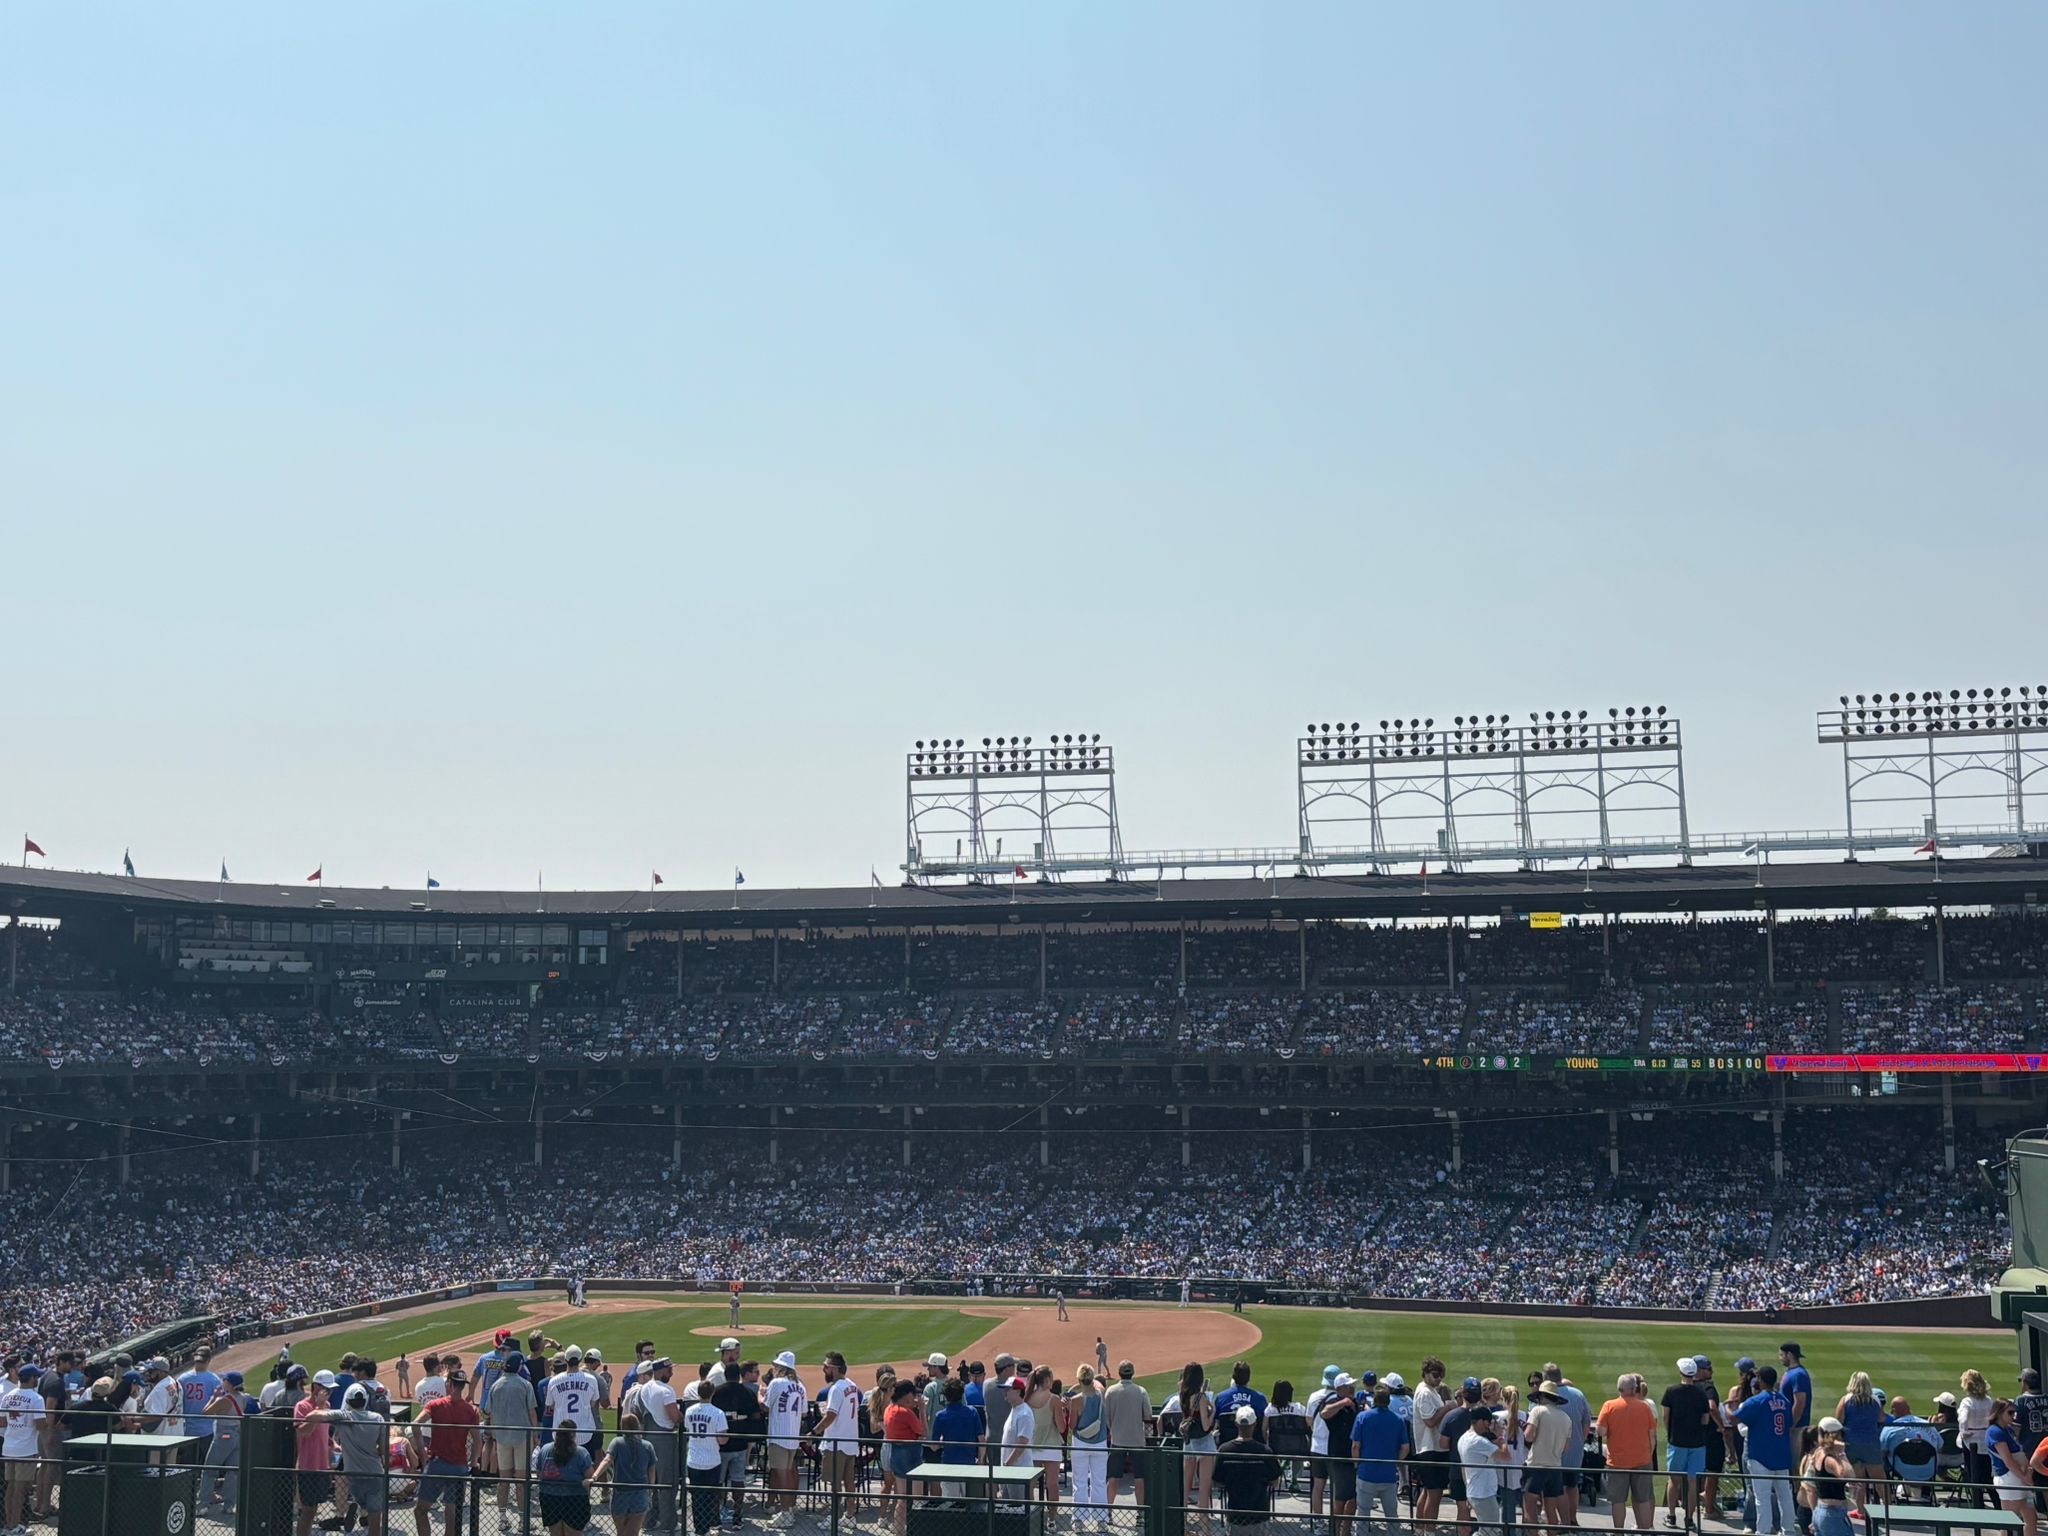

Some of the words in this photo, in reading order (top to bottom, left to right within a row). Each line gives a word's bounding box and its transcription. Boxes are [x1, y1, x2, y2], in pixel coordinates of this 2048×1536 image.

[1436, 1057, 1454, 1068] 4TH
[1480, 1057, 1486, 1068] 2
[1514, 1057, 1520, 1068] 2
[1565, 1057, 1599, 1069] YOUNG
[1633, 1059, 1646, 1067] ERA
[1691, 1059, 1701, 1069] 55
[186, 1382, 205, 1401] 25
[556, 1381, 589, 1393] HOERNER
[567, 1393, 579, 1413] 2
[1232, 1392, 1252, 1402] SOSA
[791, 1396, 800, 1416] 4
[850, 1397, 857, 1419] 7
[1774, 1412, 1785, 1435] 9
